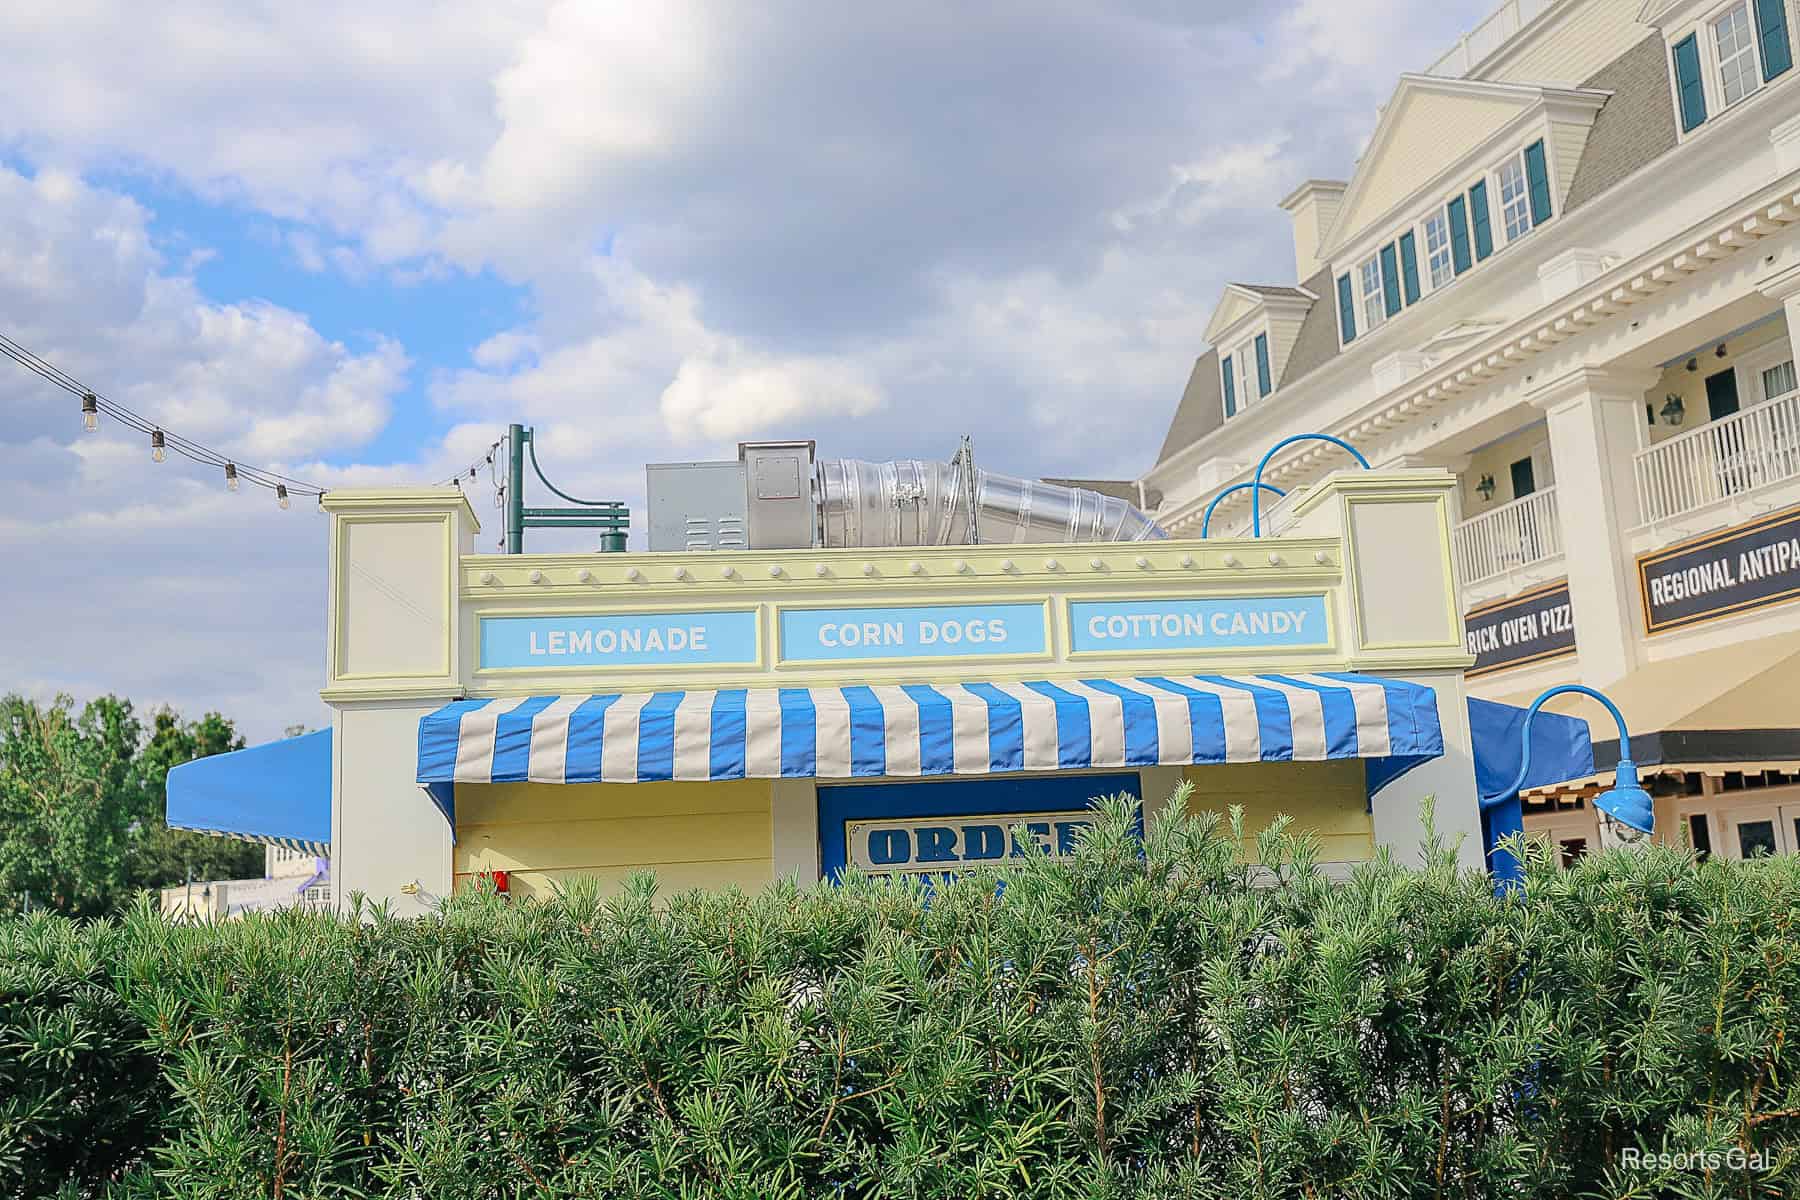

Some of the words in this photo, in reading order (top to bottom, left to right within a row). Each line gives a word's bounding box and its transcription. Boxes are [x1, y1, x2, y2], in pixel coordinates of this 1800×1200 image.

[1650, 558, 1736, 606] REGIONAL
[818, 623, 905, 648] CORN
[919, 619, 1009, 644] DOGS
[1088, 613, 1204, 639] COTTON
[1210, 610, 1308, 636] CANDY
[1465, 624, 1500, 655] RICK
[1501, 613, 1539, 647] OVEN
[529, 626, 708, 656] LEMONADE
